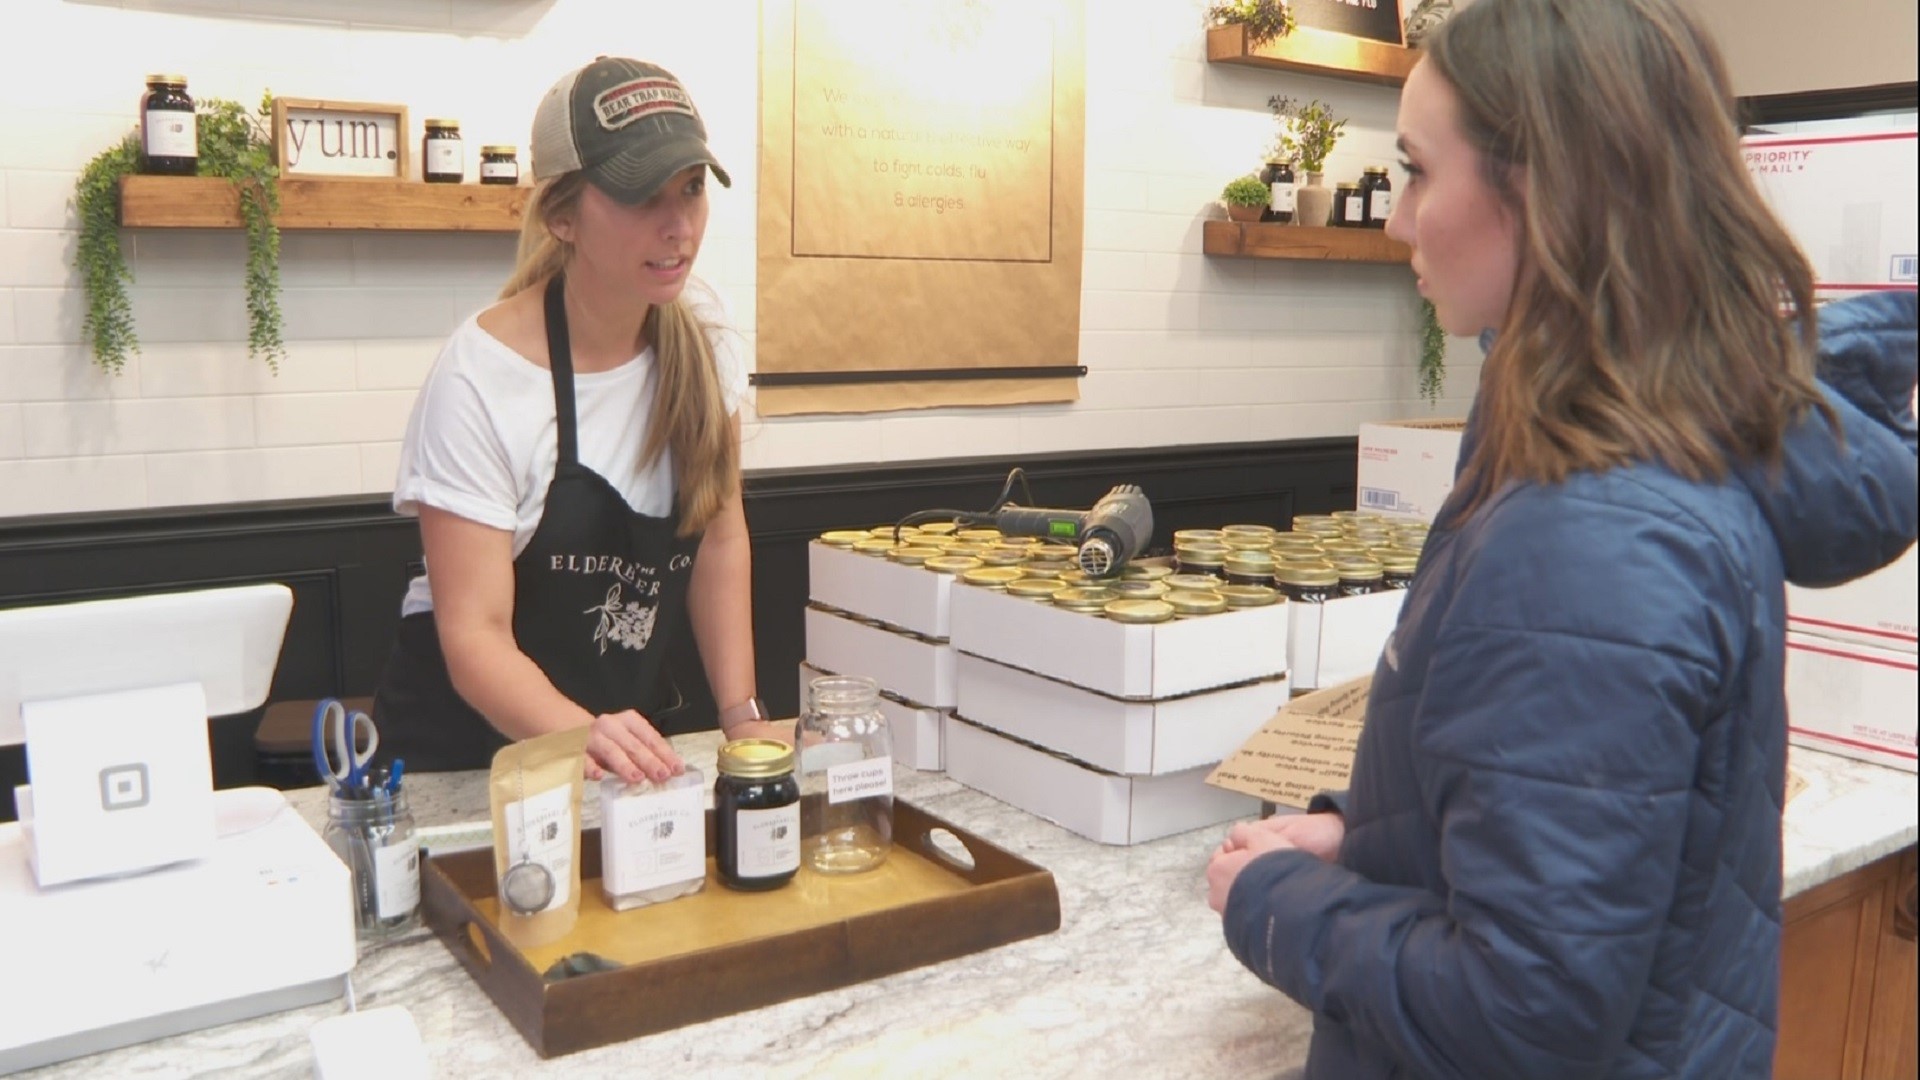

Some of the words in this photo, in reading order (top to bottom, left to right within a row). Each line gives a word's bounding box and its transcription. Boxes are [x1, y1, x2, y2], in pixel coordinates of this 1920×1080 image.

[602, 97, 631, 117] BEAR
[632, 90, 660, 103] TRAP
[287, 119, 397, 167] yum.
[821, 124, 853, 139] with
[857, 127, 867, 139] a
[1005, 136, 1031, 153] way
[1746, 150, 1811, 164] PRIORITY
[873, 159, 889, 173] to
[893, 159, 922, 180] fight
[926, 163, 965, 179] colds,
[969, 164, 987, 180] flu
[1759, 164, 1793, 174] MAIL
[894, 192, 904, 207] &
[832, 773, 859, 783] Throw
[1241, 775, 1282, 788] Priority
[833, 785, 853, 796] here
[1284, 781, 1316, 792] using
[1260, 788, 1302, 801] Service
